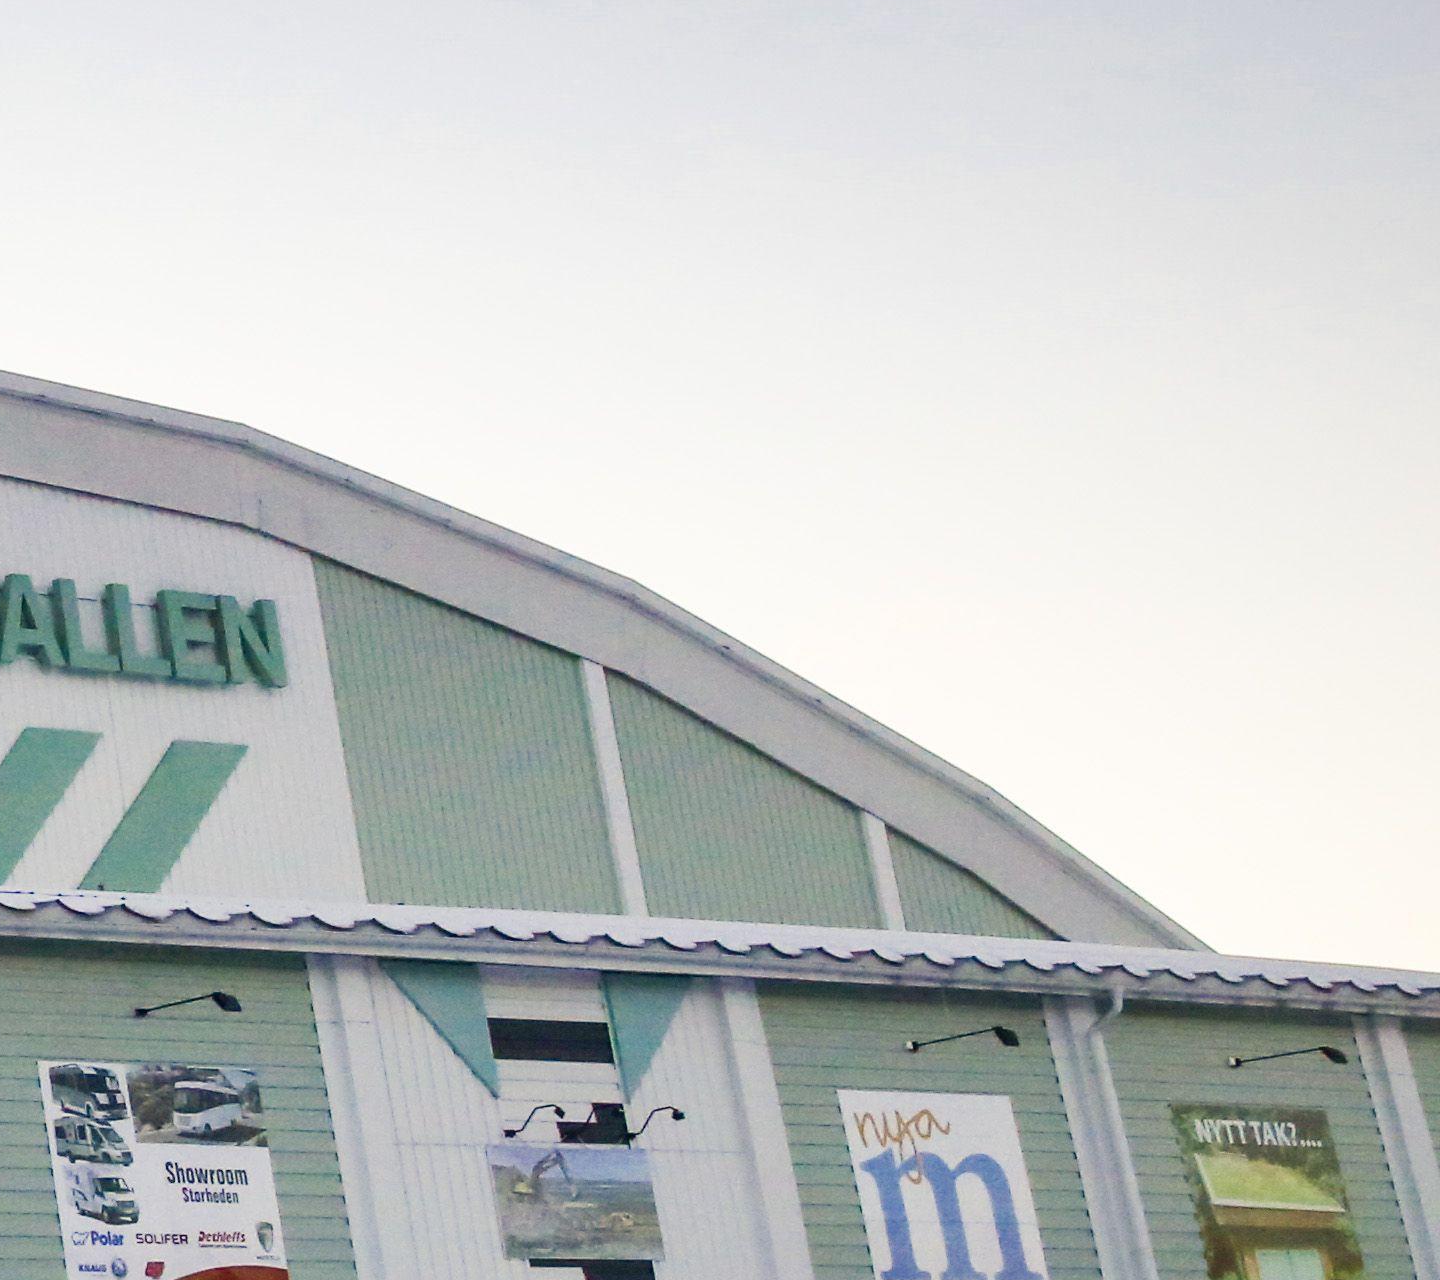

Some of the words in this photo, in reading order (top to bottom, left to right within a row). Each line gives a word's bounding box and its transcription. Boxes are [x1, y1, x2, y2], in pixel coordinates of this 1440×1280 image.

[1194, 1119, 1247, 1145] NYTT
[165, 1161, 249, 1186] Showroom
[182, 1186, 239, 1204] Storheden
[91, 1231, 124, 1246] Polar
[136, 1233, 189, 1245] SOLIFER
